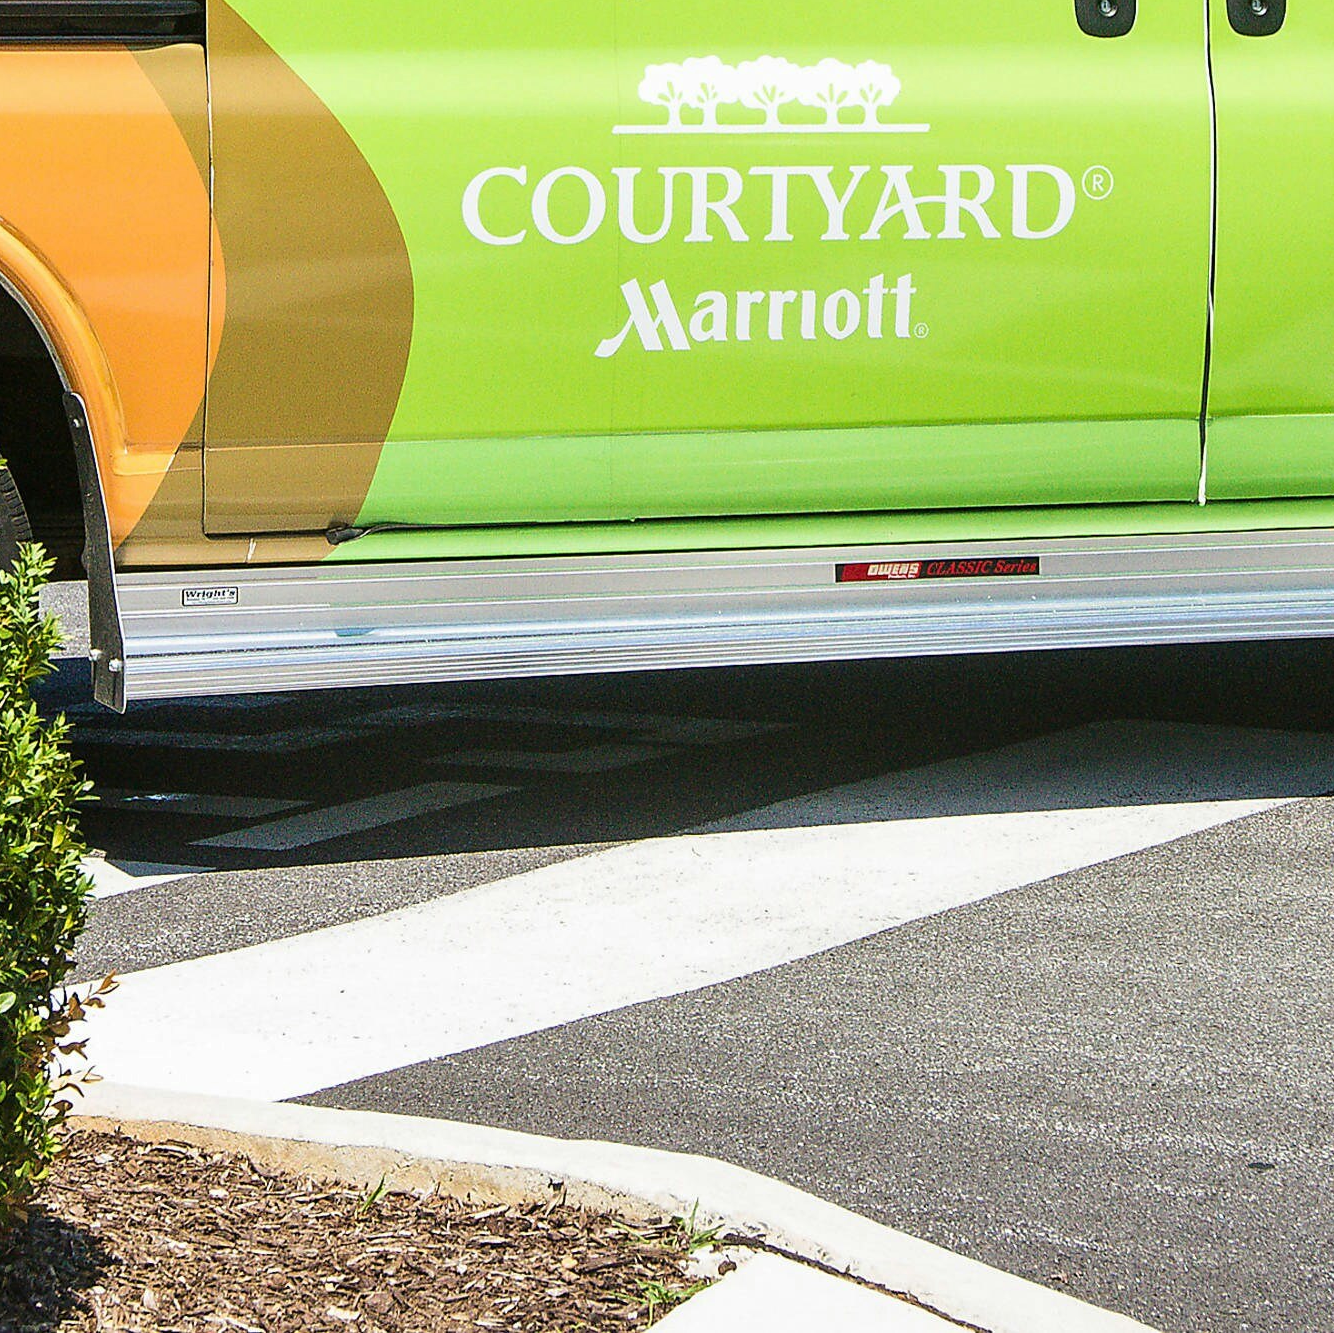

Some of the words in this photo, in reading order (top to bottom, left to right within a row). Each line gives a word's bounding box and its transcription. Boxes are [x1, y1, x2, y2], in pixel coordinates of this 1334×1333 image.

[461, 164, 1076, 246] COURTYARD
[594, 273, 917, 358] Marriott
[927, 560, 993, 576] CLASSIC
[994, 558, 1037, 573] Series
[185, 589, 235, 598] Wright's
